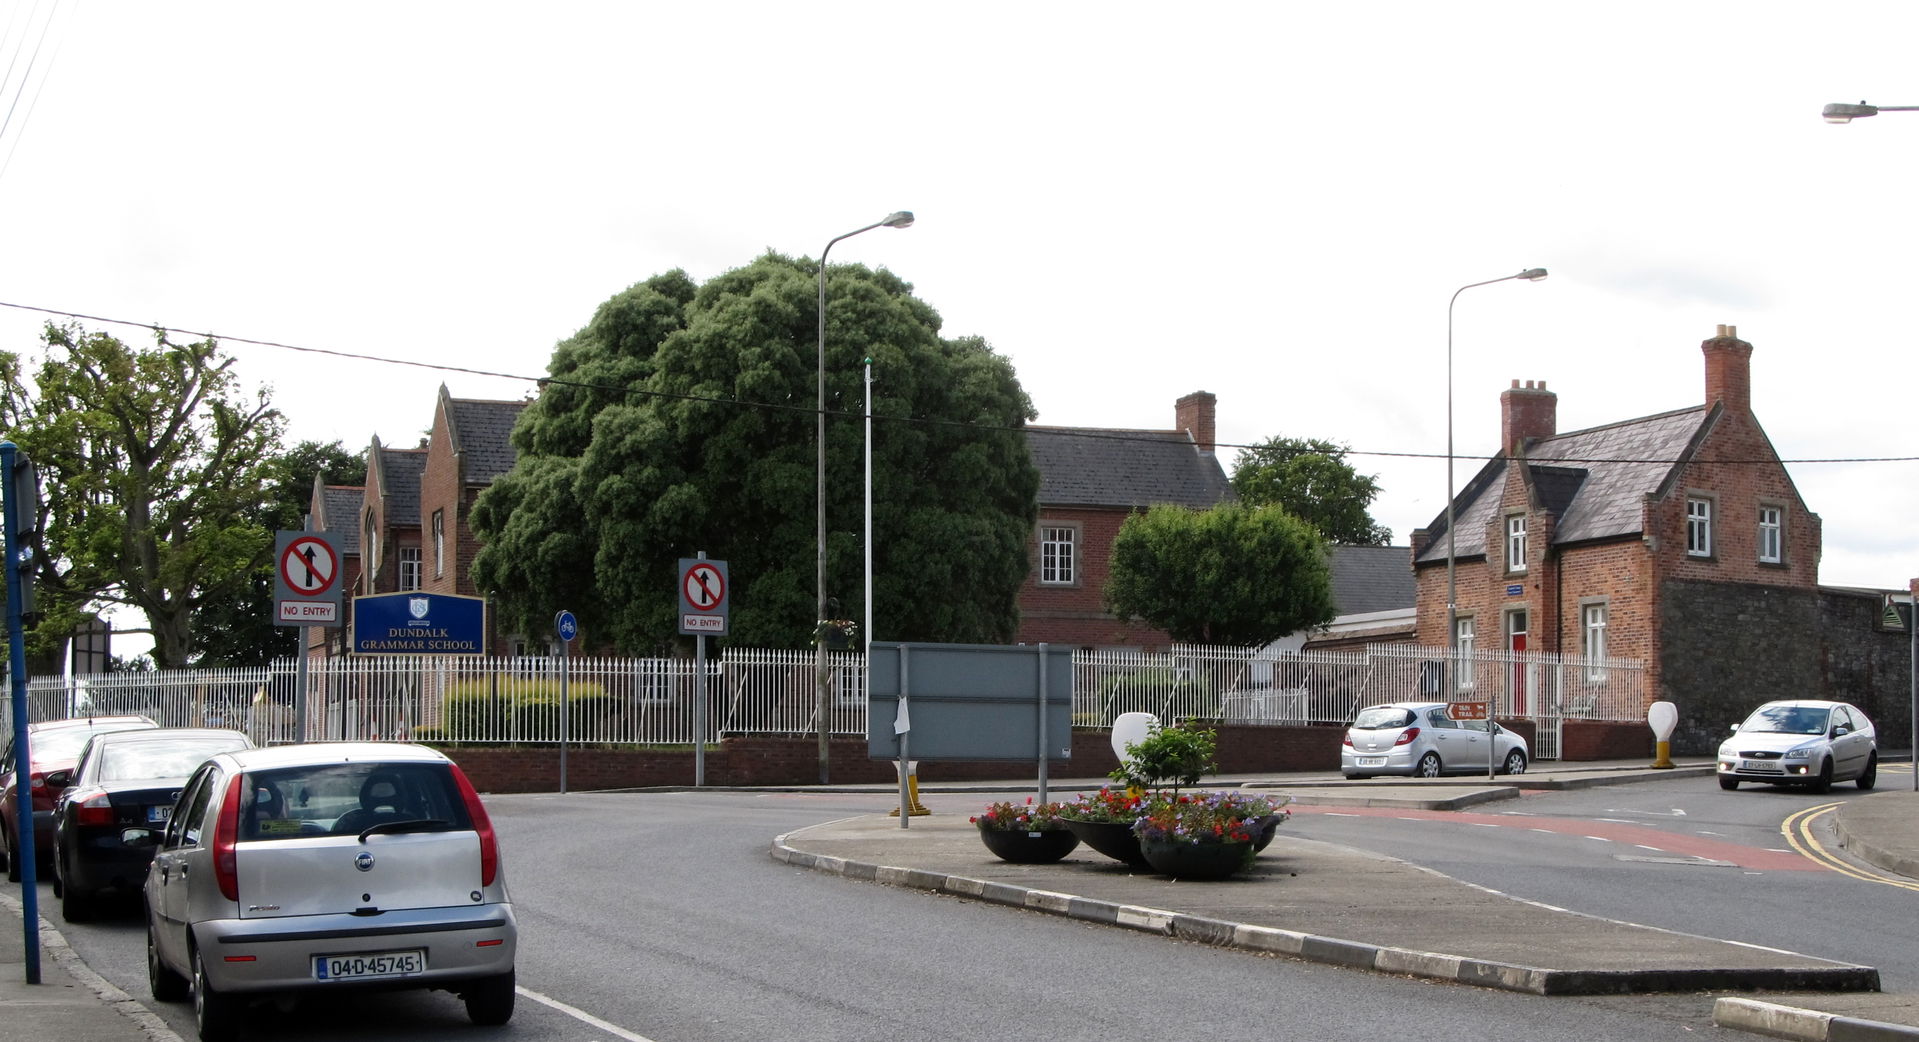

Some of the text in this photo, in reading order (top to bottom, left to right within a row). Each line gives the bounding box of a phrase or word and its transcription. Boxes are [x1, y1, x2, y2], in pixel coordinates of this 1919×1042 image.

[284, 606, 332, 616] NO ENTRY
[389, 628, 448, 638] DUNDALK
[361, 639, 476, 650] GRAMMAR SCHOOL
